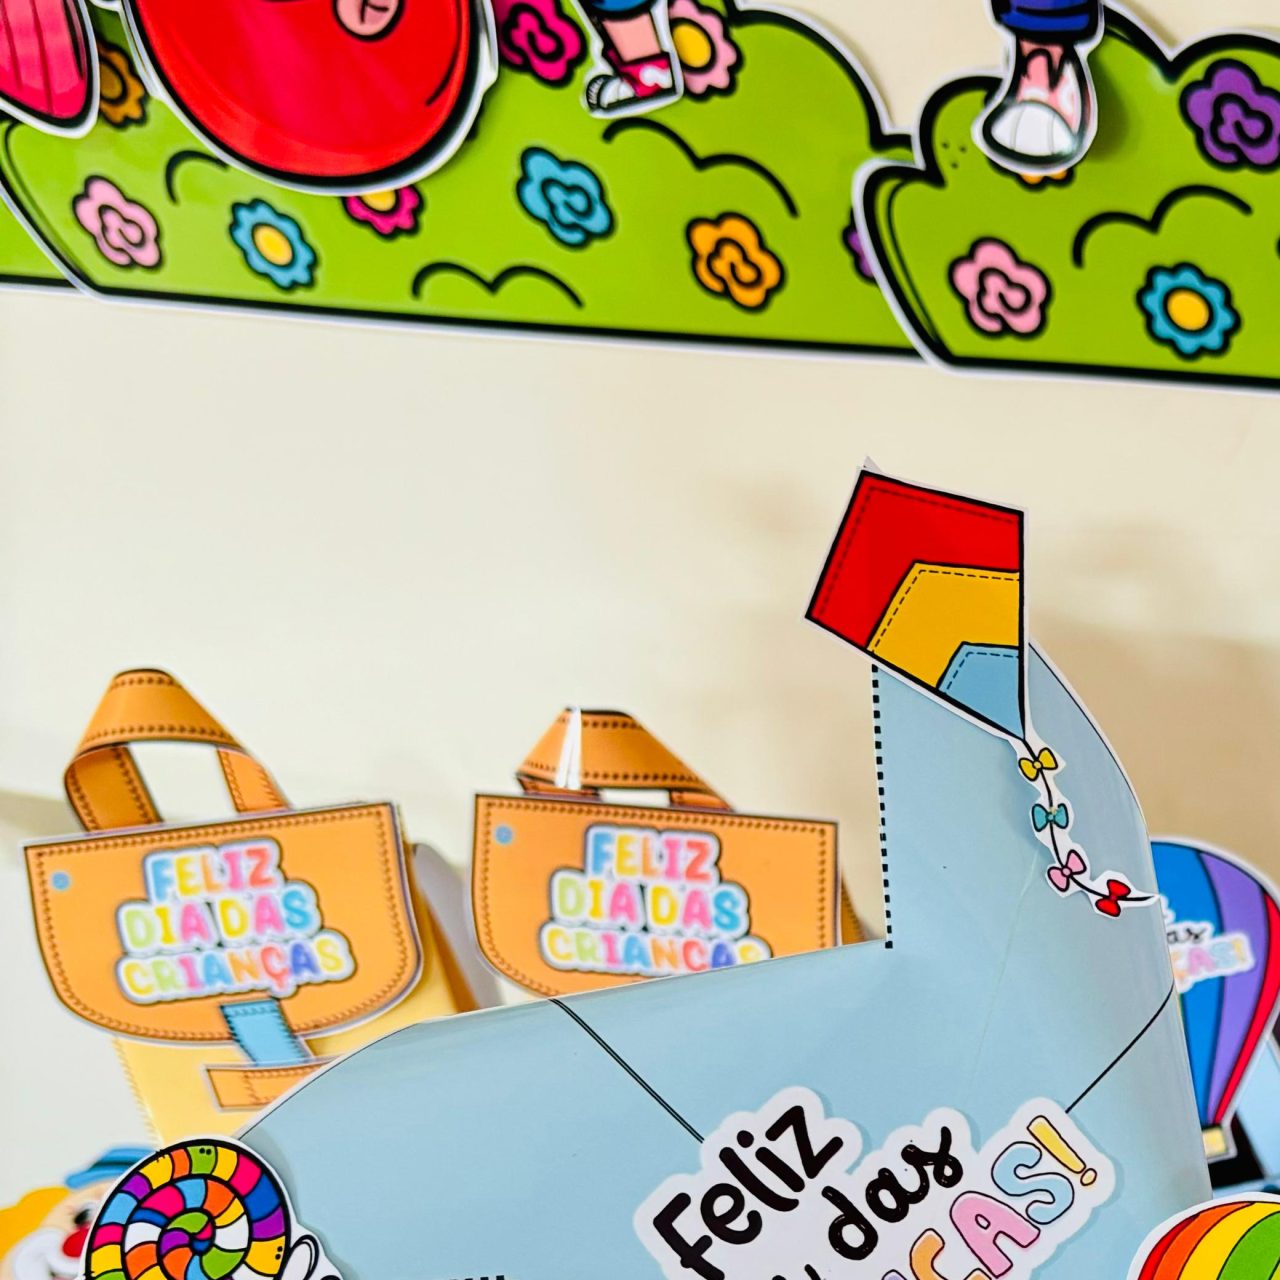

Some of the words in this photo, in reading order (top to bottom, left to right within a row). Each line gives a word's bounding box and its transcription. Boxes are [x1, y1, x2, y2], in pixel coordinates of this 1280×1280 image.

[151, 846, 275, 900] FELIZ
[591, 832, 710, 882] FELIZ
[123, 902, 209, 948] DIA
[218, 889, 311, 938] DAS
[557, 877, 637, 924] DIA
[651, 885, 741, 932] DAS
[123, 937, 345, 995] CRIANÇAS
[822, 1125, 964, 1261] das
